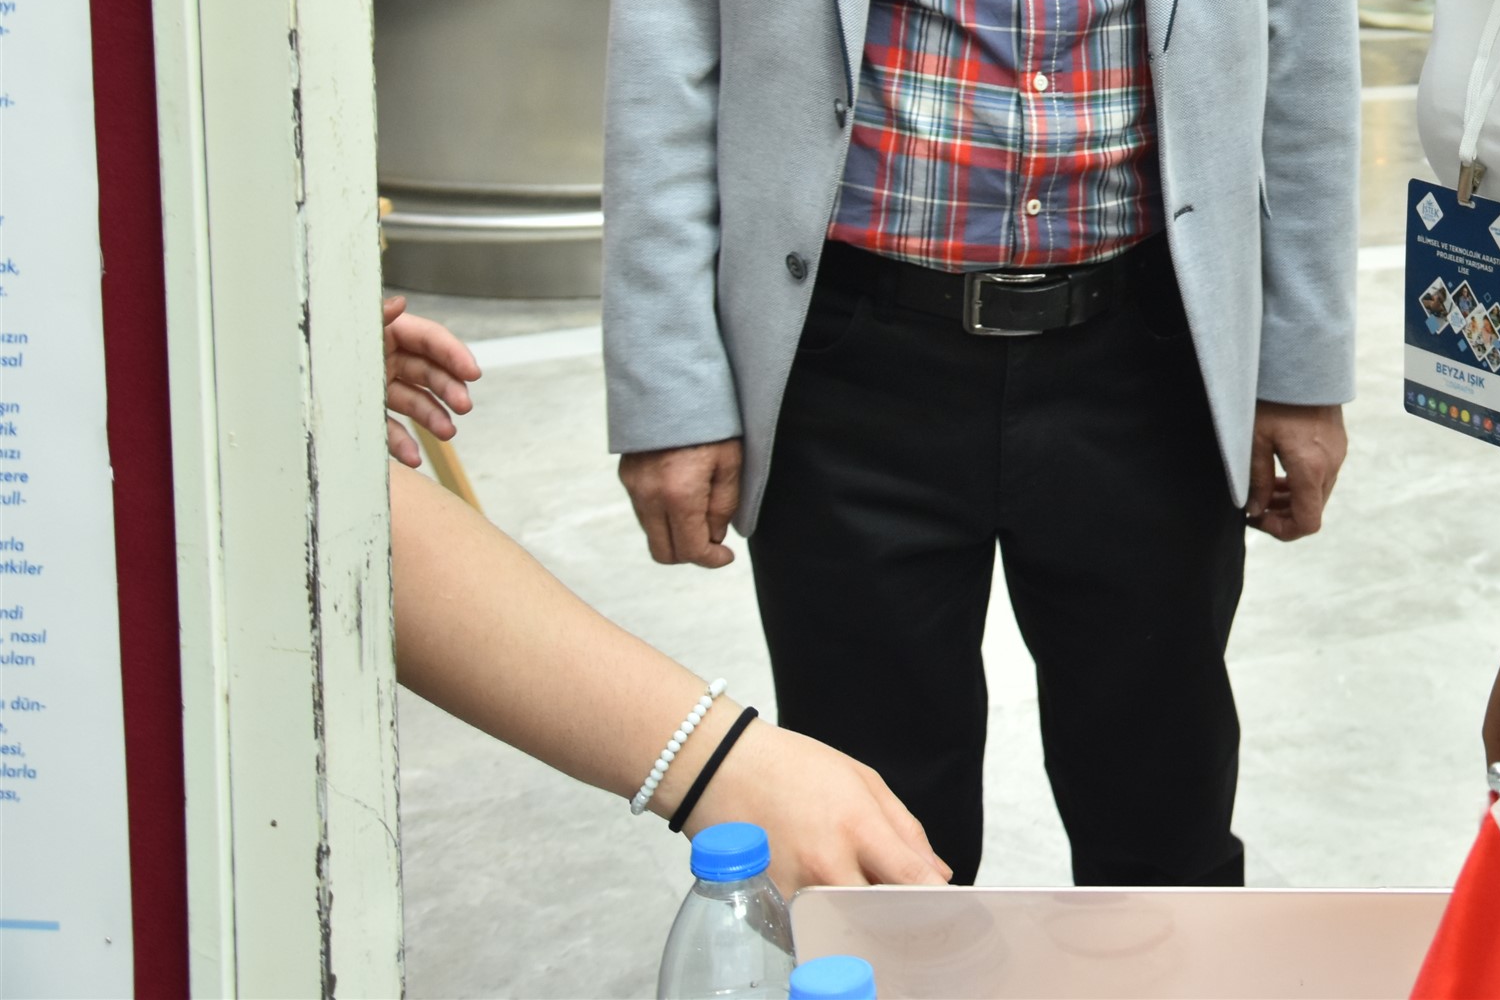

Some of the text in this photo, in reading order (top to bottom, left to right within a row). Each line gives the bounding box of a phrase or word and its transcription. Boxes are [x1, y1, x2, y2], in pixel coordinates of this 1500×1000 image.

[1435, 361, 1466, 382] BEYZA
[1467, 373, 1485, 389] IŞIK
[10, 628, 47, 644] nasıl
